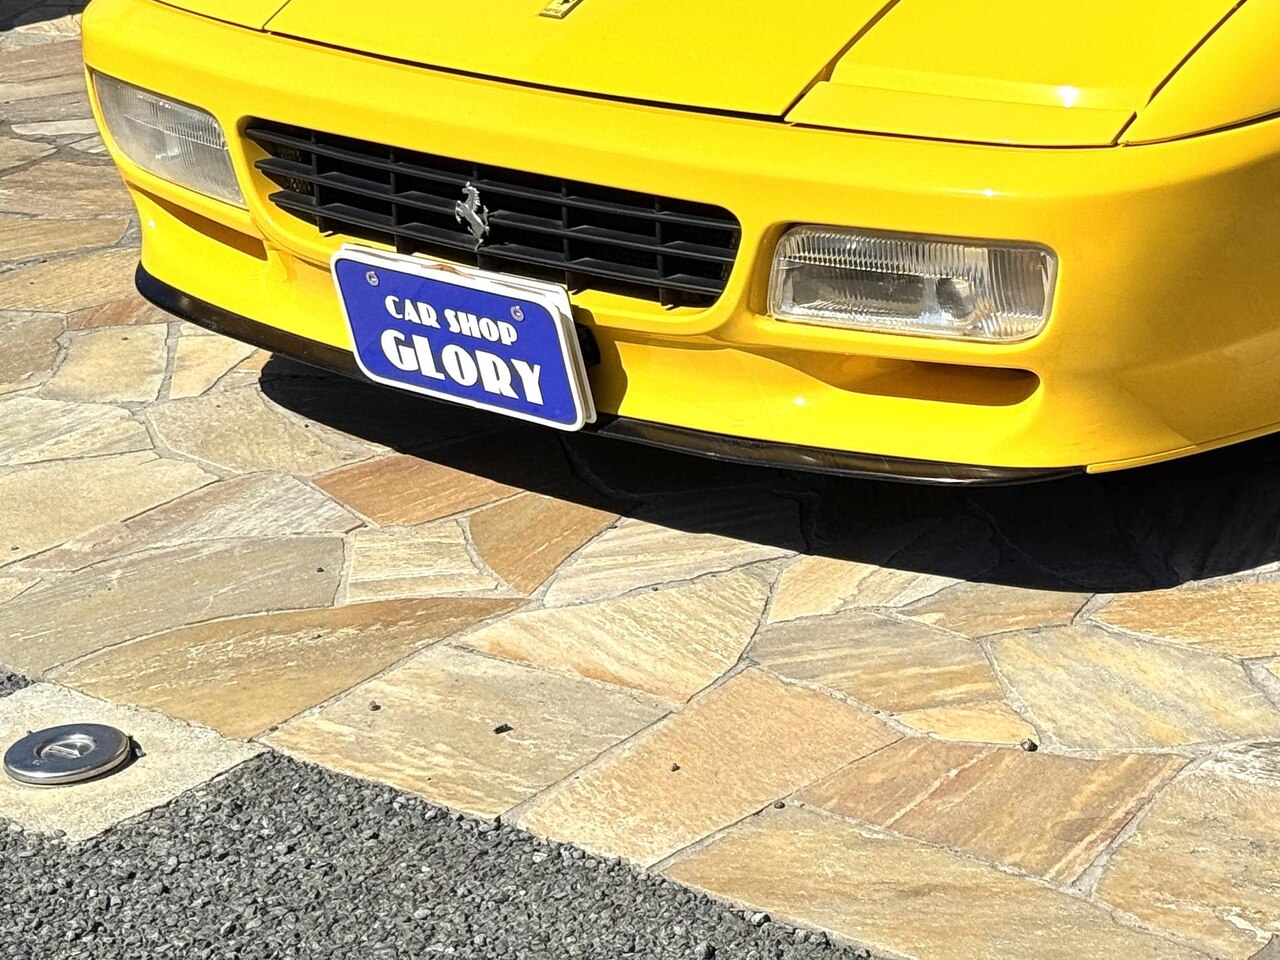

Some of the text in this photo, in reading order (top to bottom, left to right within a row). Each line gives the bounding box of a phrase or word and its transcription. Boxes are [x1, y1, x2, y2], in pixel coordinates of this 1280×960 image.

[384, 295, 518, 346] CAR SHOP
[380, 329, 544, 405] GLORY
